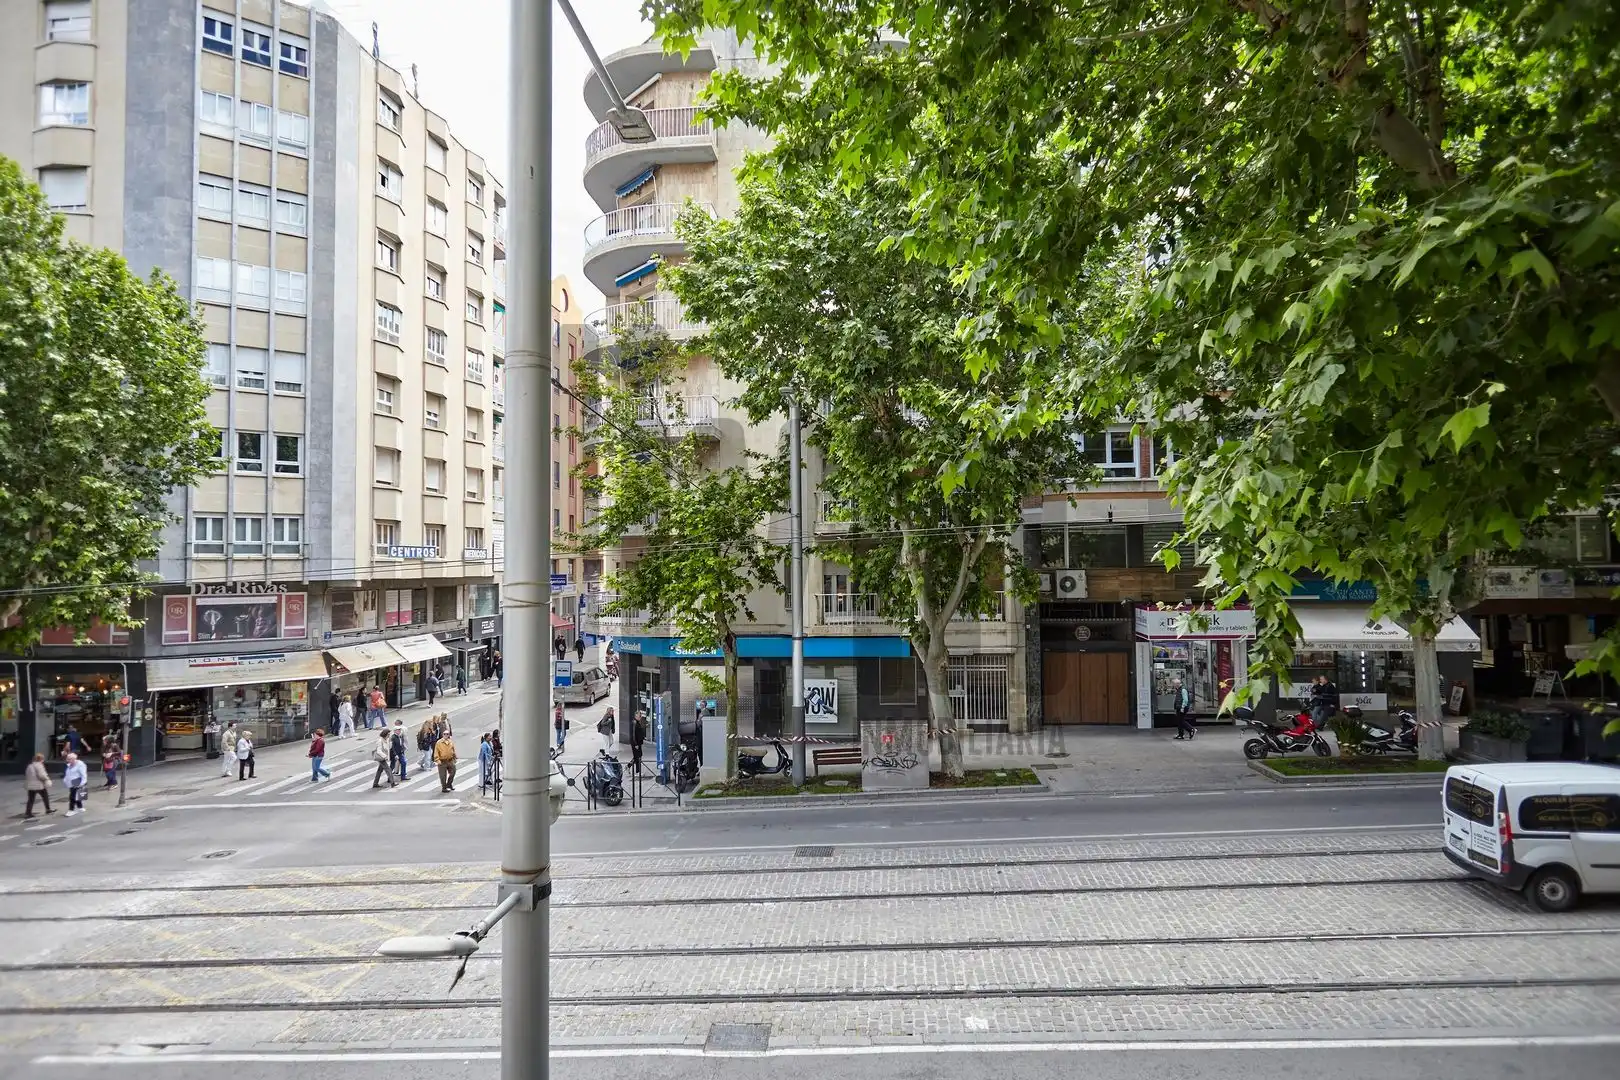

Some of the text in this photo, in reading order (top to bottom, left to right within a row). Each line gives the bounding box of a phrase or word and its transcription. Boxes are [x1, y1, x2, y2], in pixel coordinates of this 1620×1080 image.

[390, 546, 436, 558] CENTROS
[191, 581, 289, 595] Dra. Rivas
